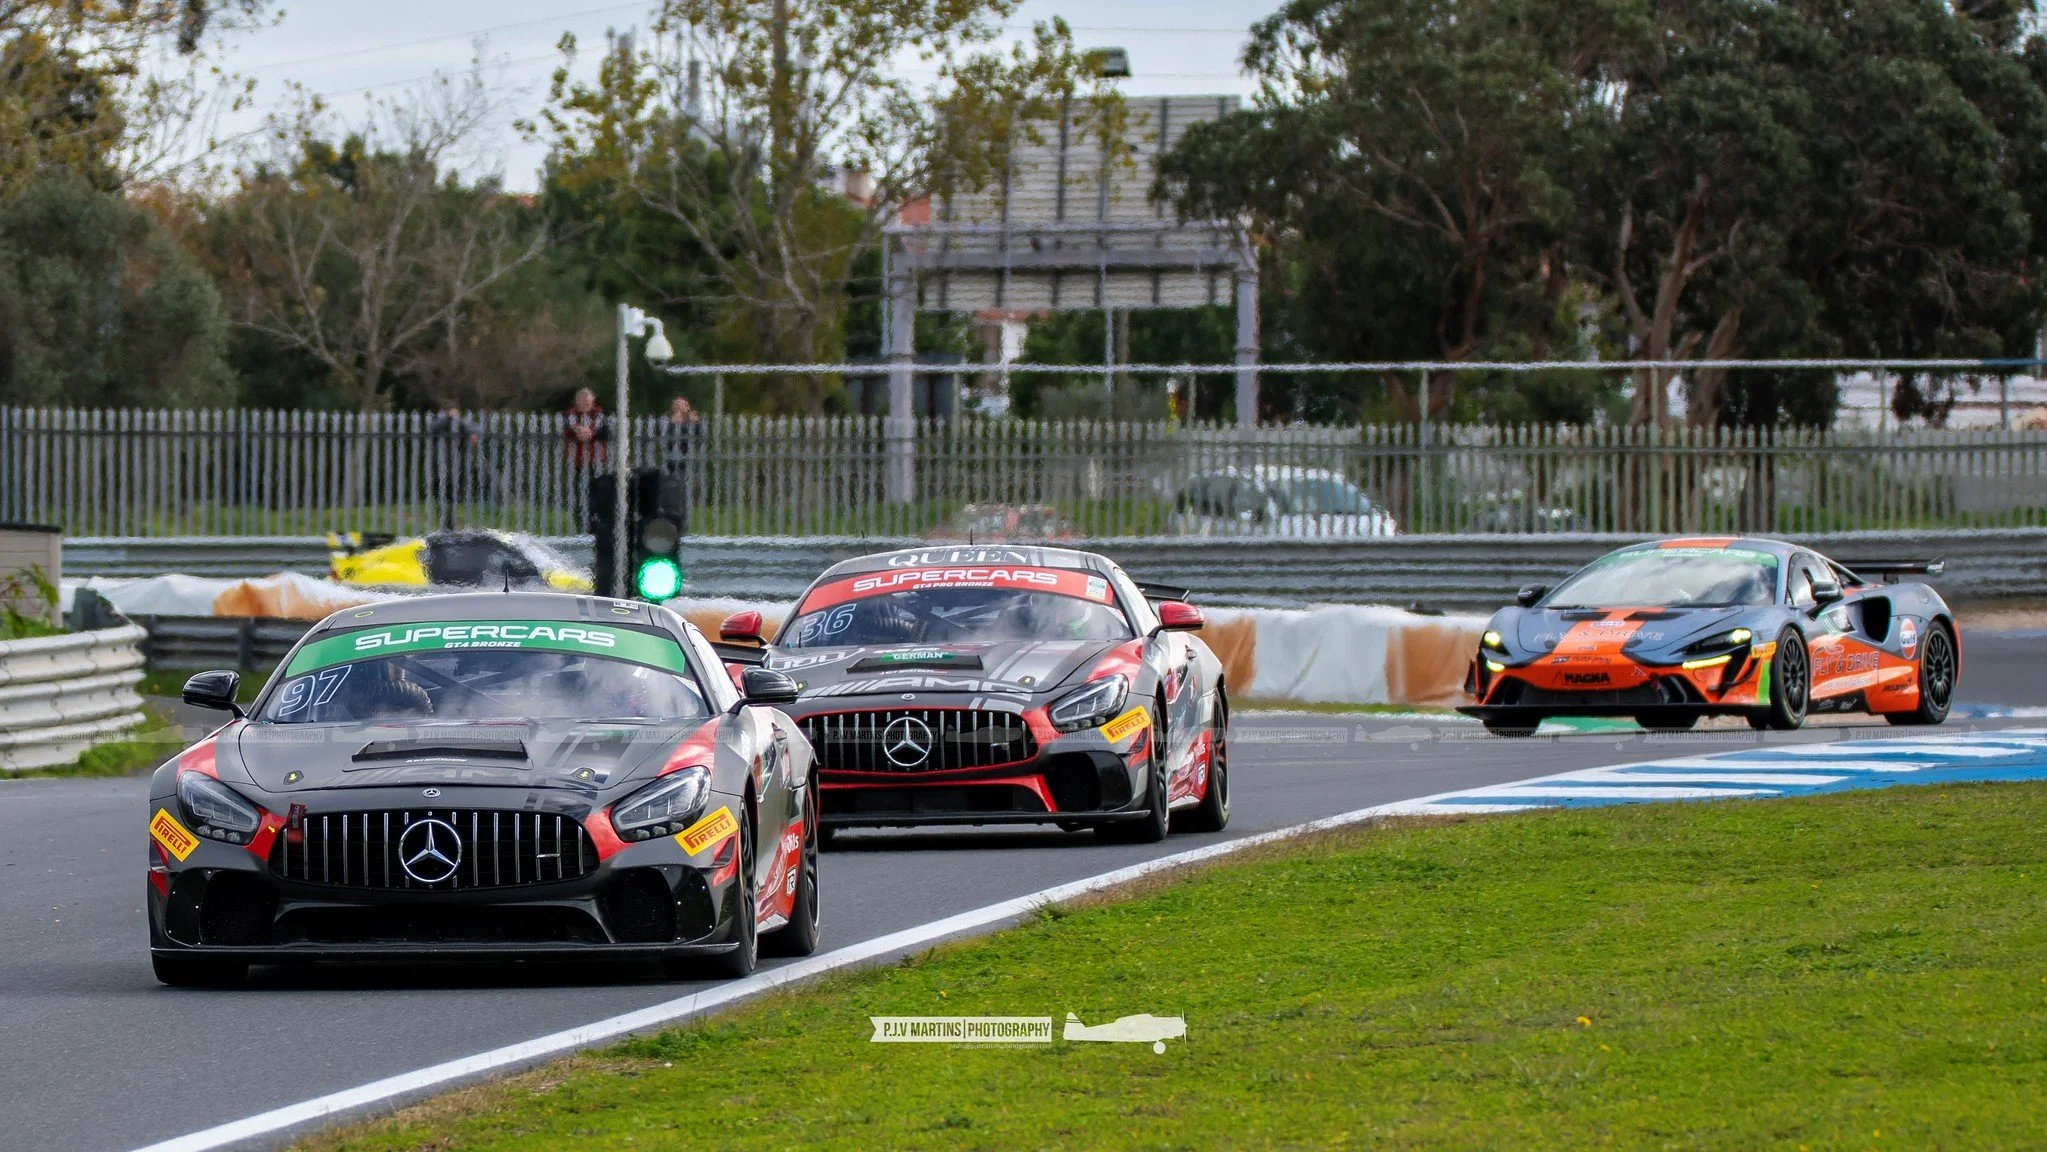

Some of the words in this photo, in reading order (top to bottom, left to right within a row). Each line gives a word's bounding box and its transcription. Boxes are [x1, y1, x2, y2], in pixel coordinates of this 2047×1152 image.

[888, 550, 1029, 567] QUEEN
[853, 570, 1058, 592] SUPERCARS
[798, 603, 857, 642] 36
[354, 625, 615, 650] SUPERCARS
[893, 652, 944, 660] GERMAN
[1846, 651, 1880, 673] DRIVE
[279, 664, 353, 717] 97
[1106, 711, 1146, 739] PIRELLI
[154, 815, 192, 855] PIRELLI
[683, 813, 731, 849] PIRELLI
